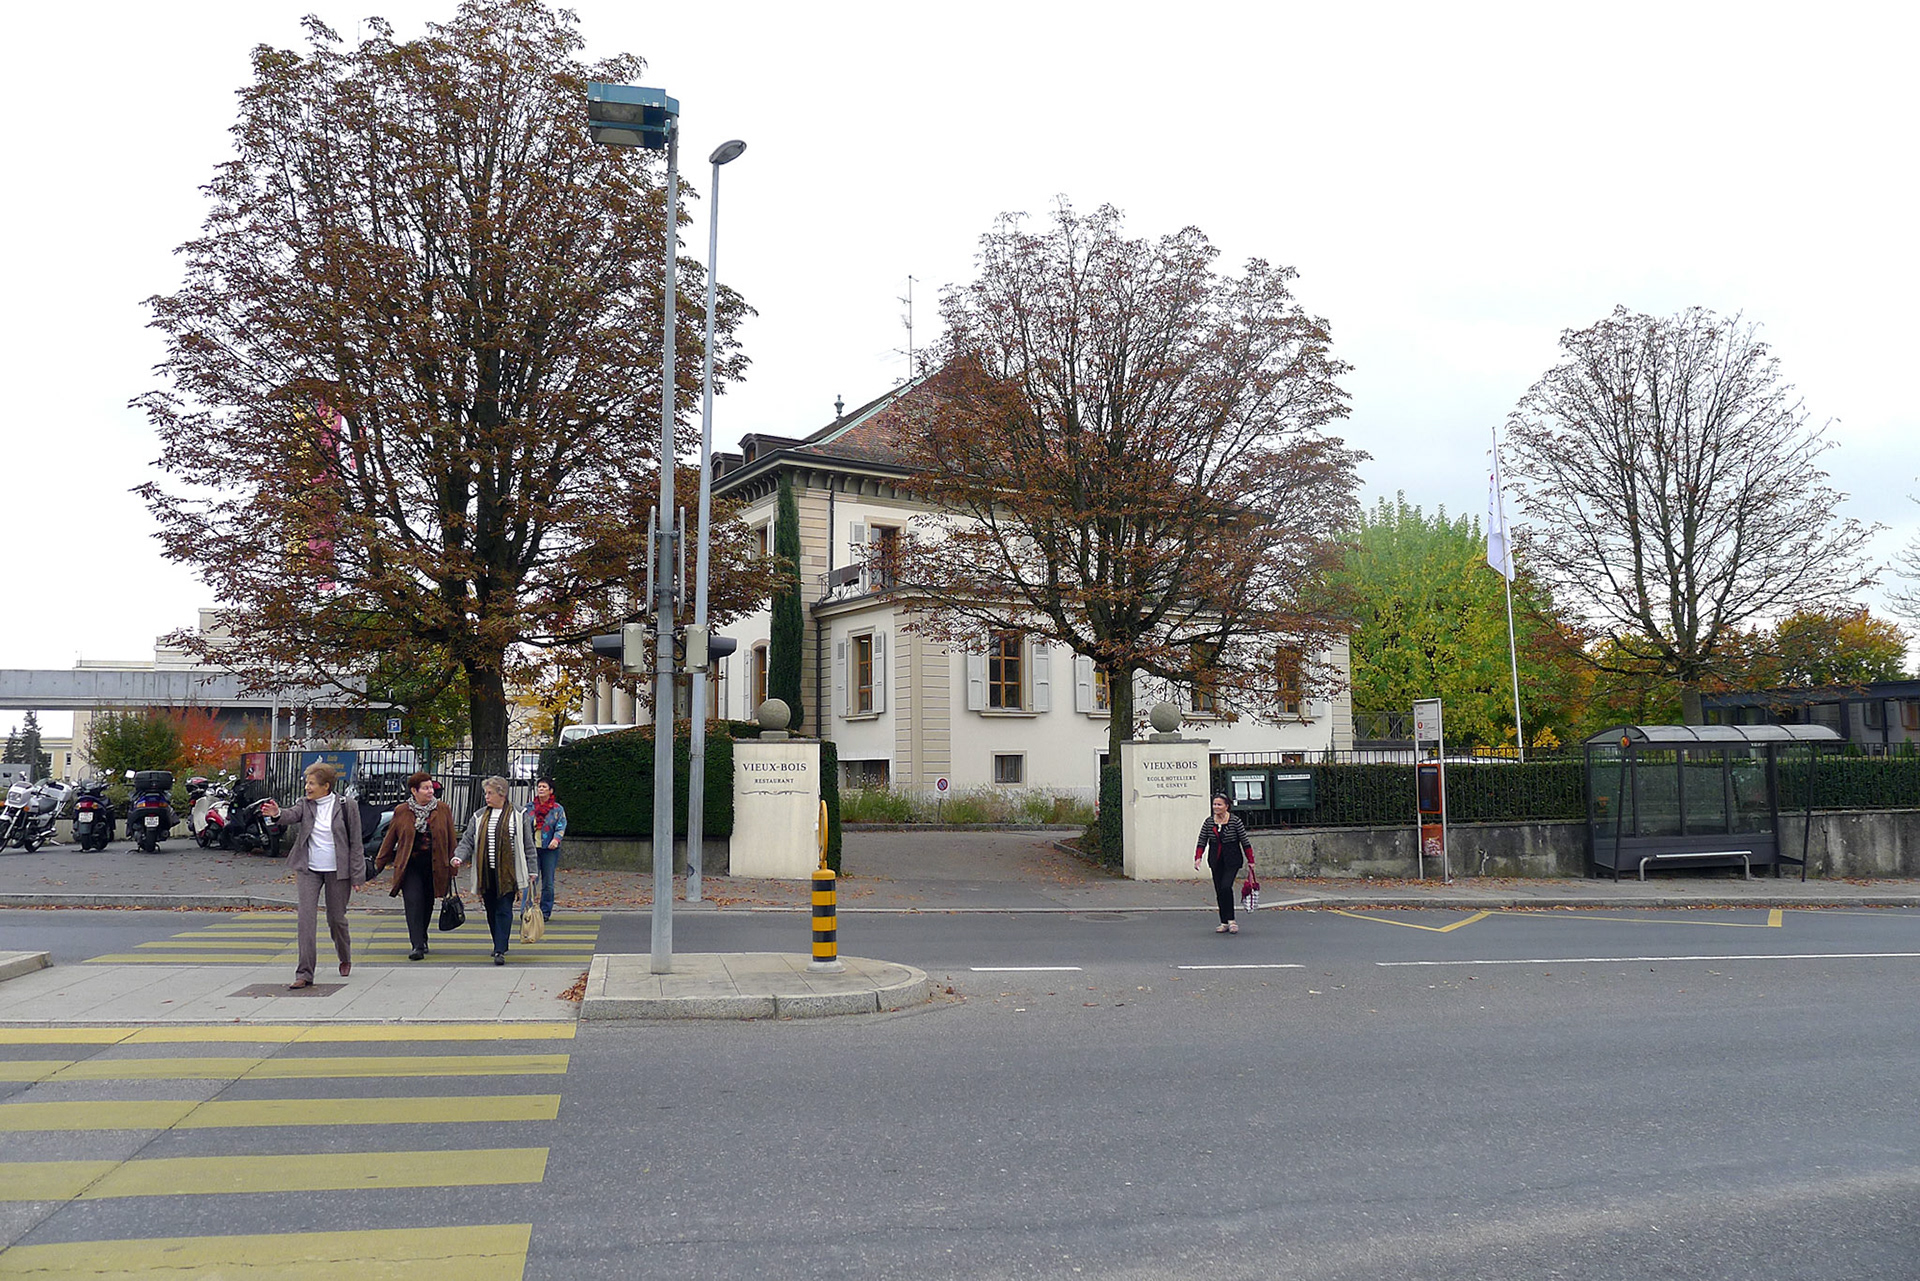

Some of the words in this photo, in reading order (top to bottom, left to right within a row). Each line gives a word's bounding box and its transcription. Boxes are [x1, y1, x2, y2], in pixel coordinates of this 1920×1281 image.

[391, 721, 398, 730] P
[743, 763, 807, 771] VIEUX-BOIS
[1143, 761, 1198, 769] VIEUX-BOIS
